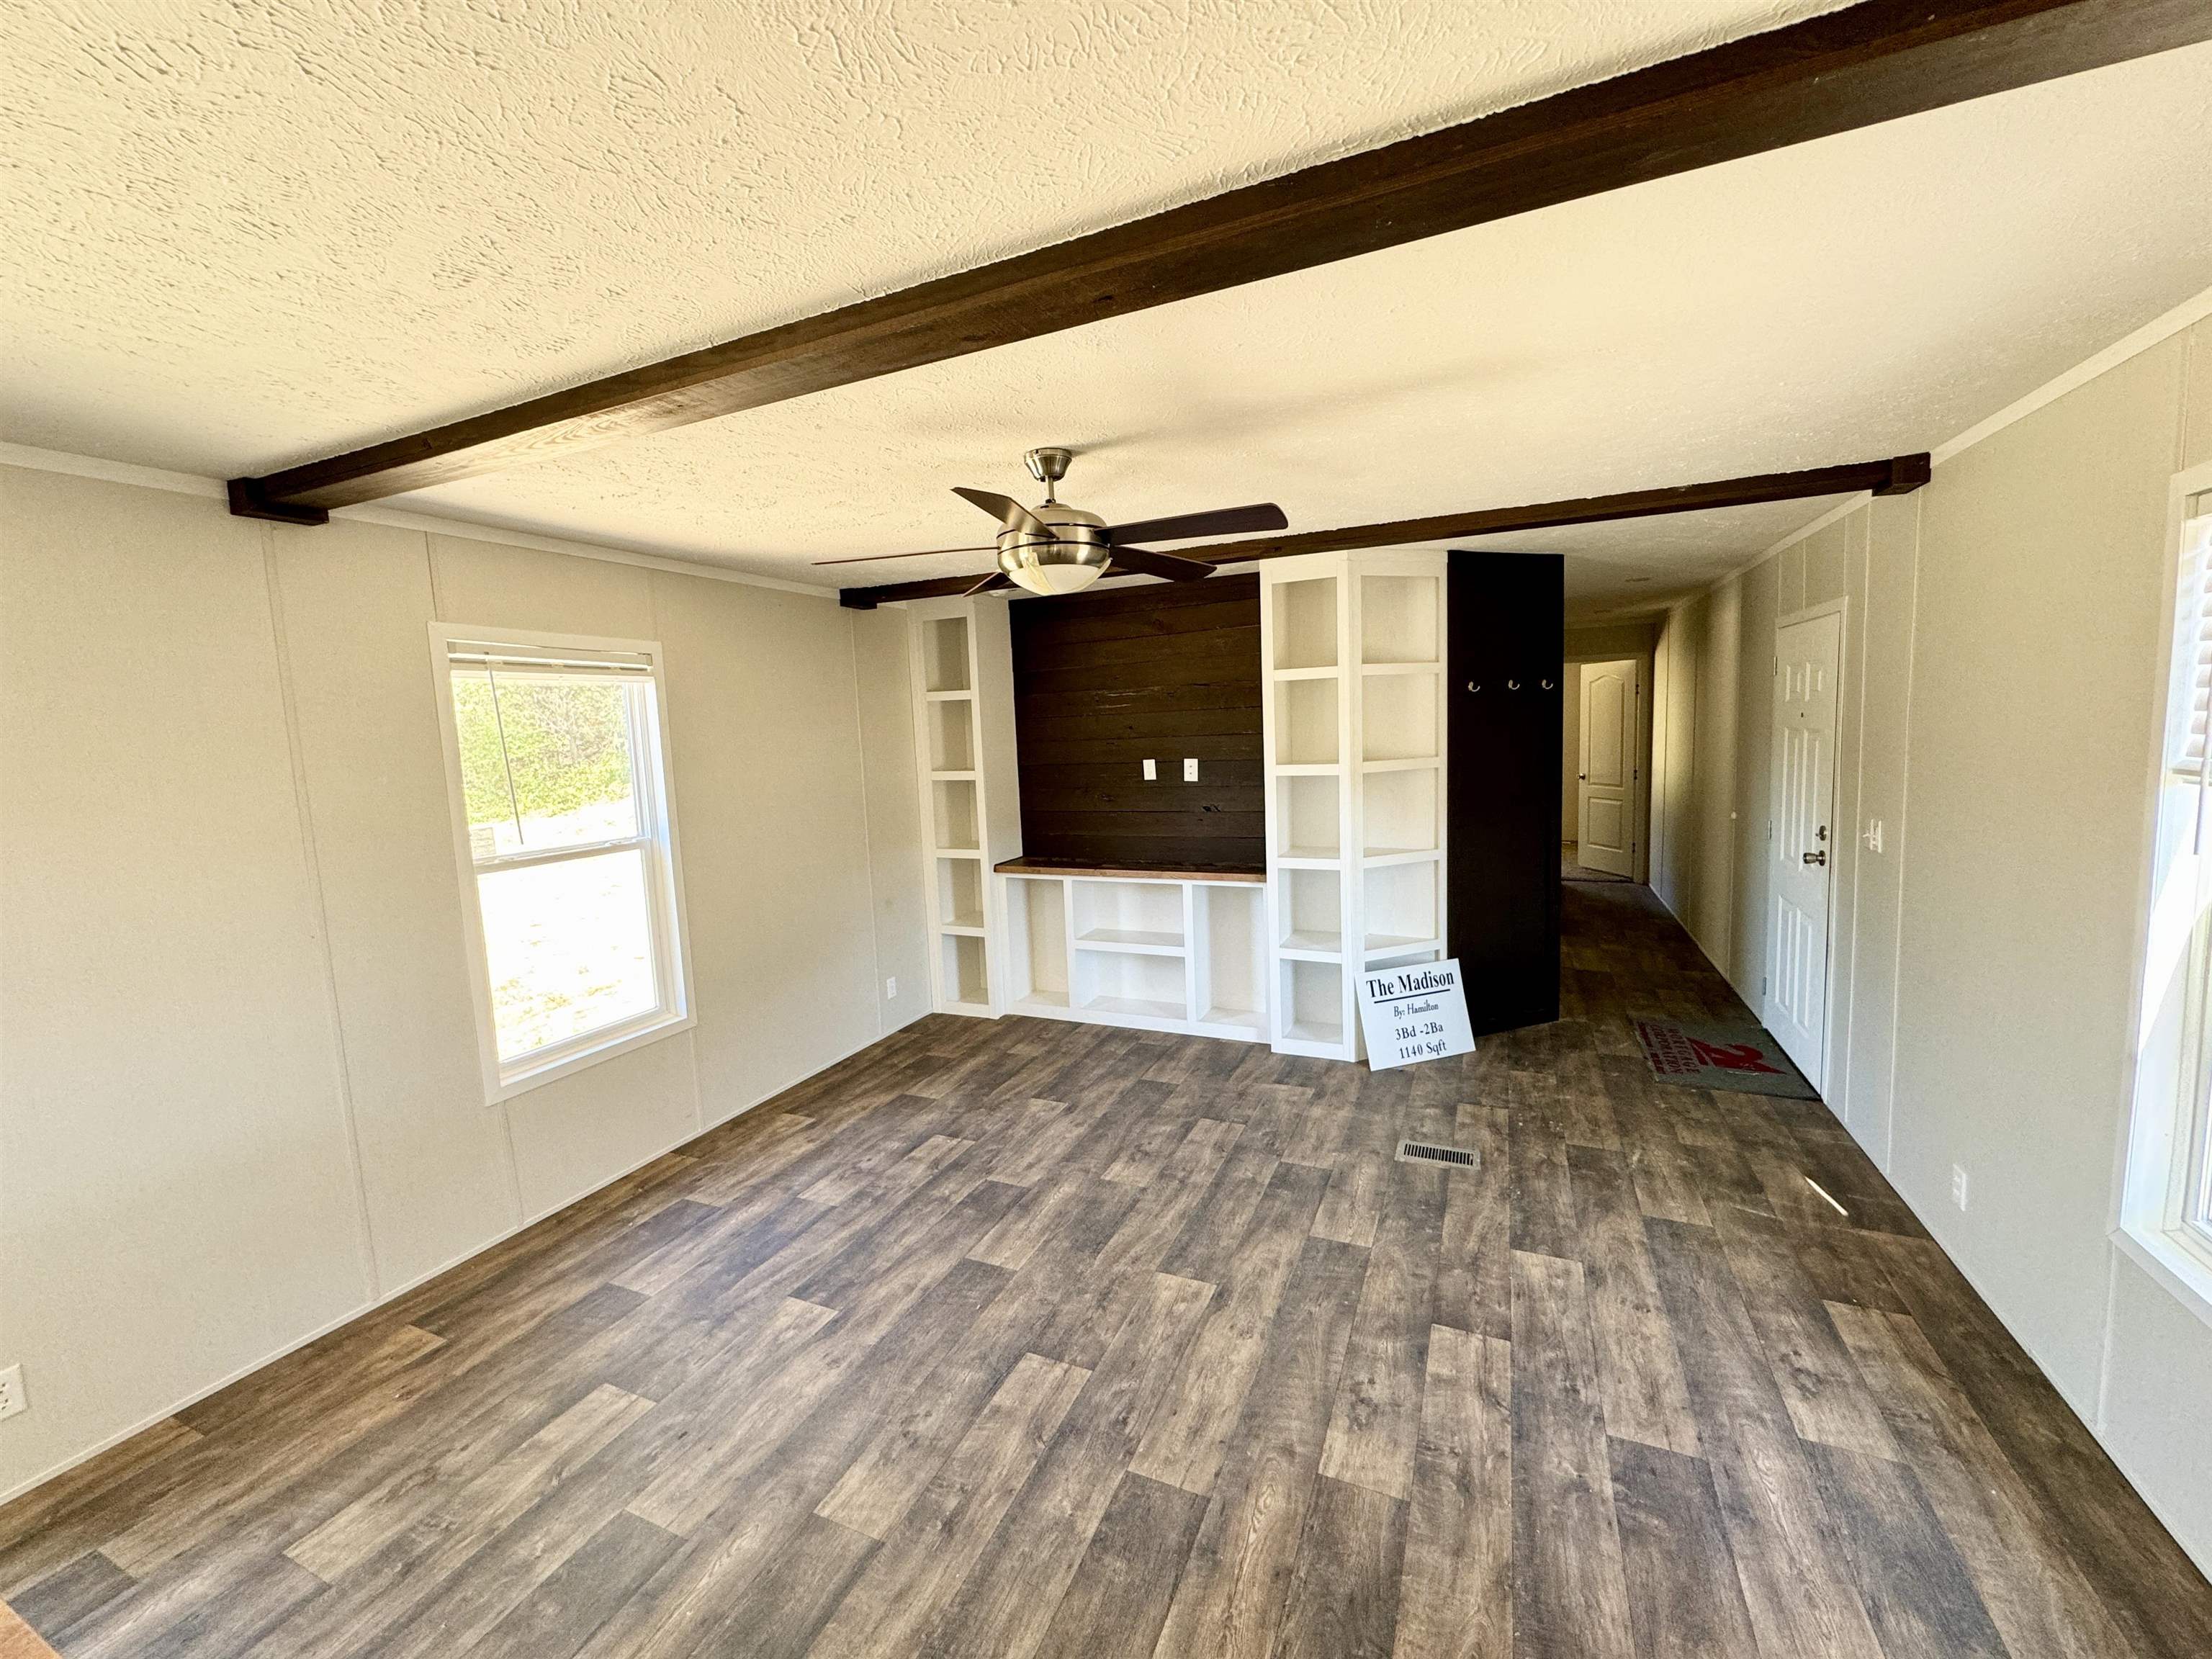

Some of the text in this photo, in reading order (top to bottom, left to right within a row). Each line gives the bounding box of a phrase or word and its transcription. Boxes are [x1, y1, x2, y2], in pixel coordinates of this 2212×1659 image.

[1366, 971, 1455, 998] The Madison
[1394, 999, 1439, 1020] By: Hamilton
[1395, 1025, 1417, 1040] 3Bd
[1399, 1039, 1447, 1059] 1140 Sqft
